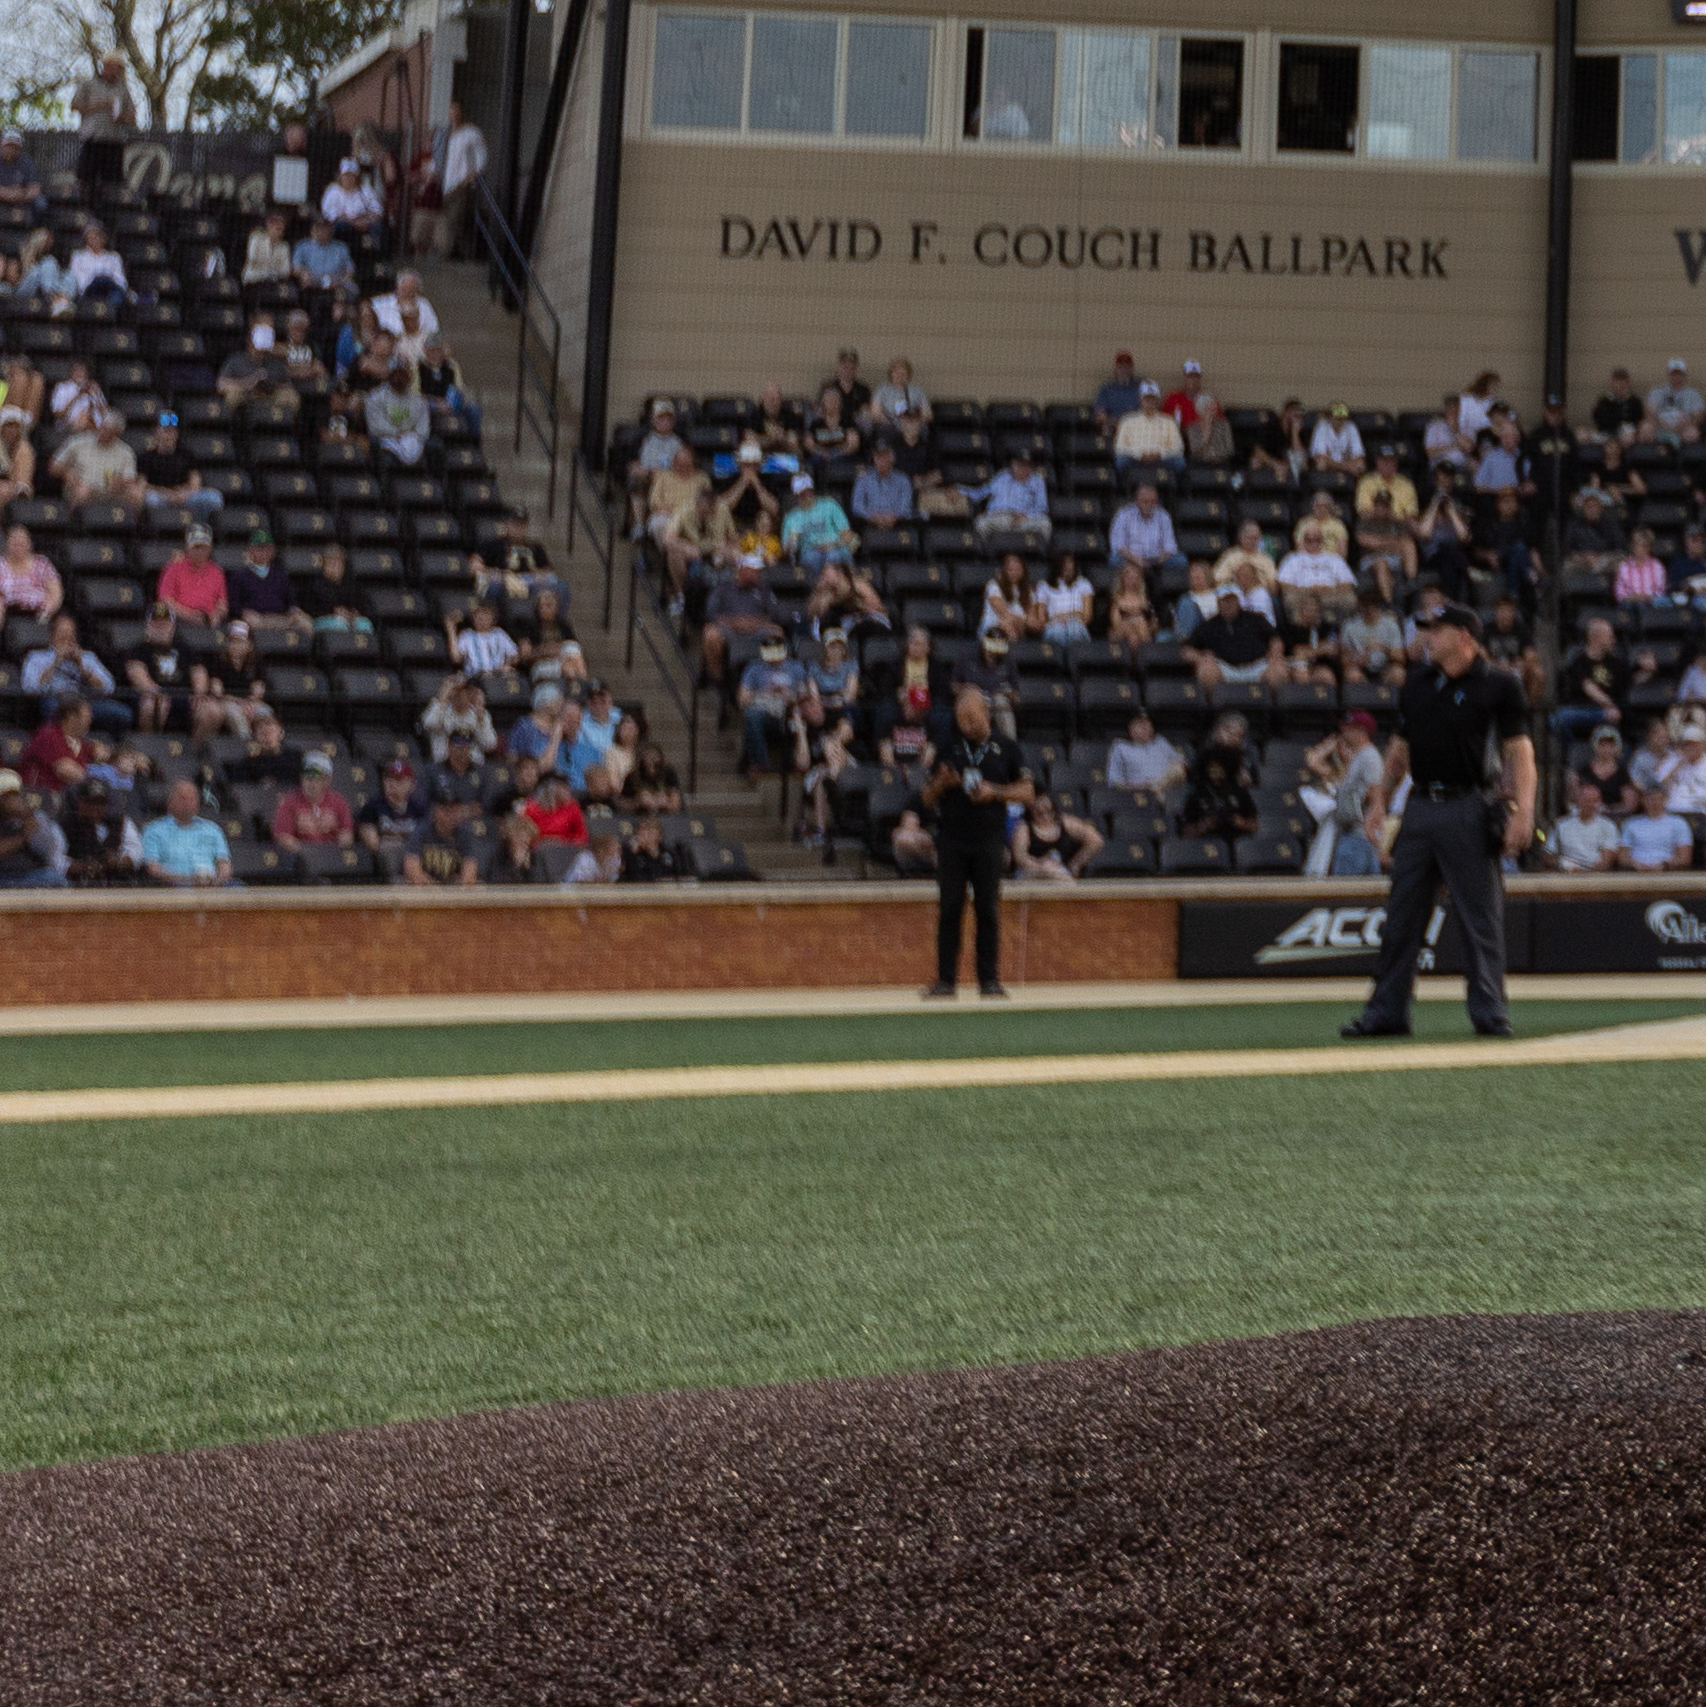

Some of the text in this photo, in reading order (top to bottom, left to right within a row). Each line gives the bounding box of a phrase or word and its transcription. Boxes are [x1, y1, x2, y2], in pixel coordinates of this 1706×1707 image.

[719, 214, 1449, 280] DAVID F. COUCH BALLPARK
